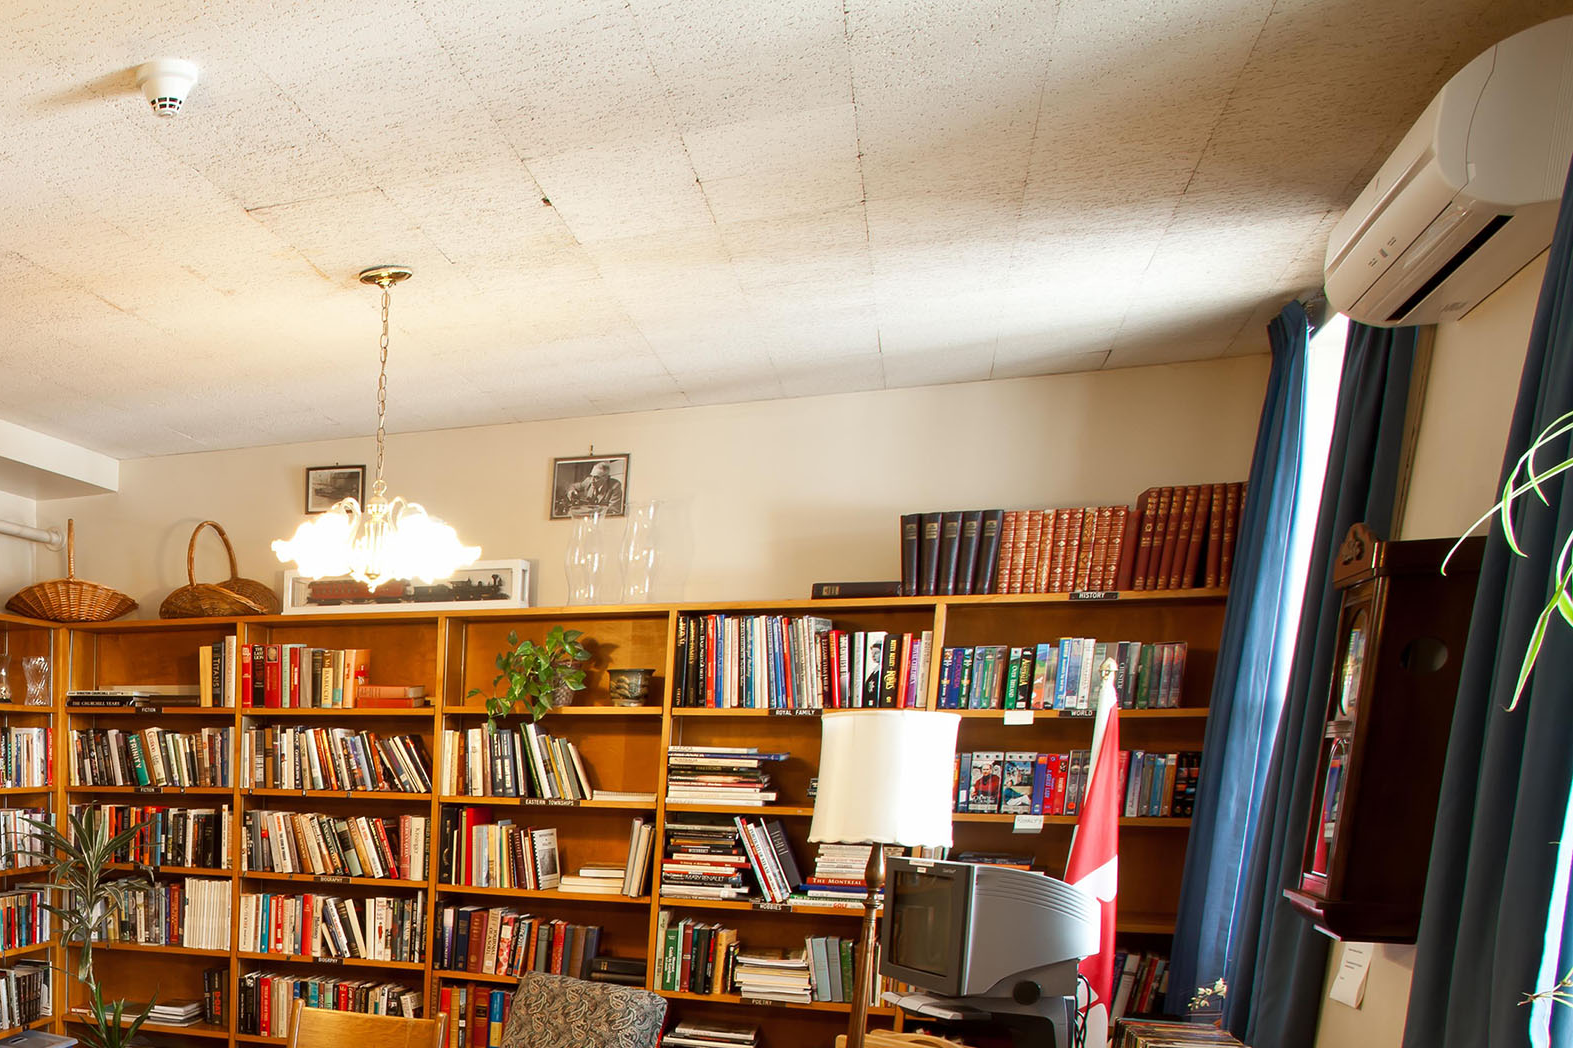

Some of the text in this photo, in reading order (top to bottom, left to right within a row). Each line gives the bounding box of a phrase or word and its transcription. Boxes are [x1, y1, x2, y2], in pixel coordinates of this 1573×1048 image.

[212, 658, 220, 688] TITANS
[130, 737, 142, 769] TRINITY
[548, 799, 574, 807] TOWNSHIPS
